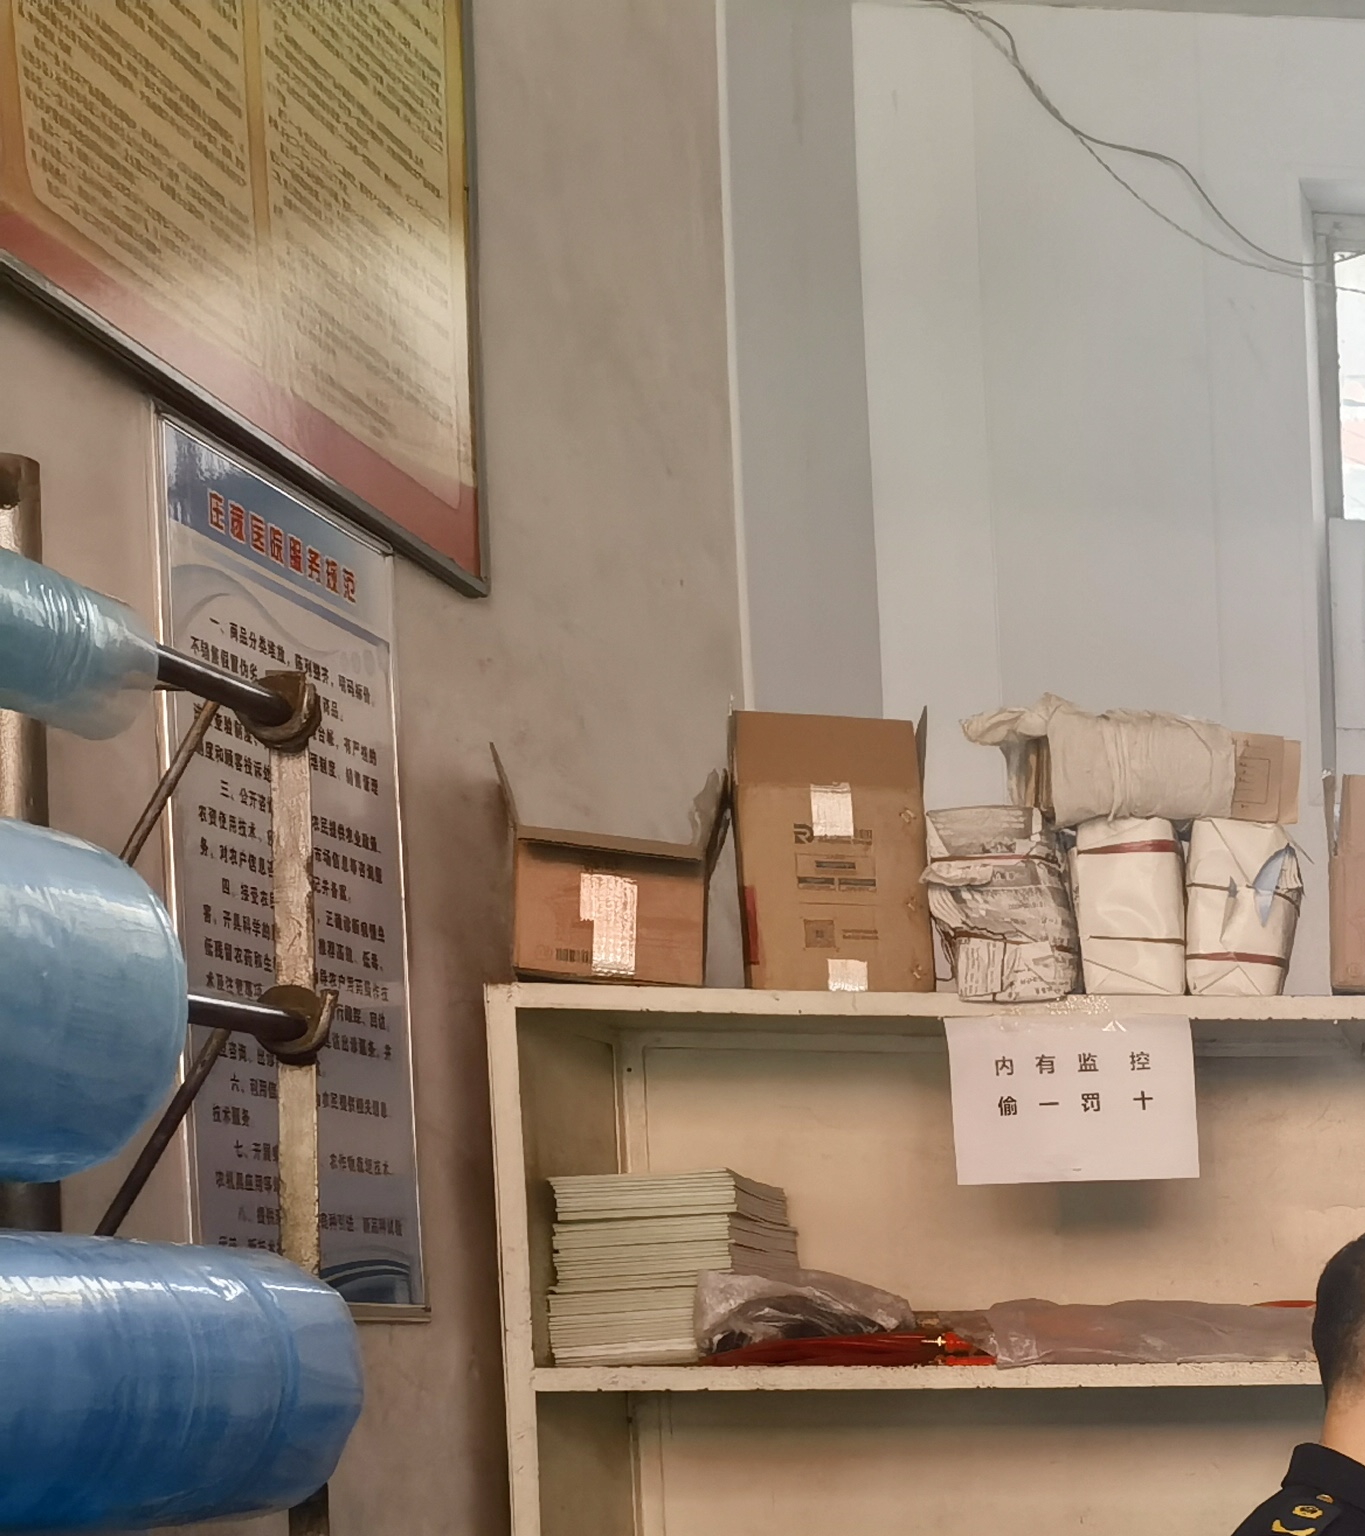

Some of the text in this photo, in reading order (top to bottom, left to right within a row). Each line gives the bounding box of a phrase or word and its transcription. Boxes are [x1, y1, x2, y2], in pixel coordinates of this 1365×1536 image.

[994, 1051, 1152, 1077] 内有监控
[997, 1090, 1154, 1117] 偷一罚十
